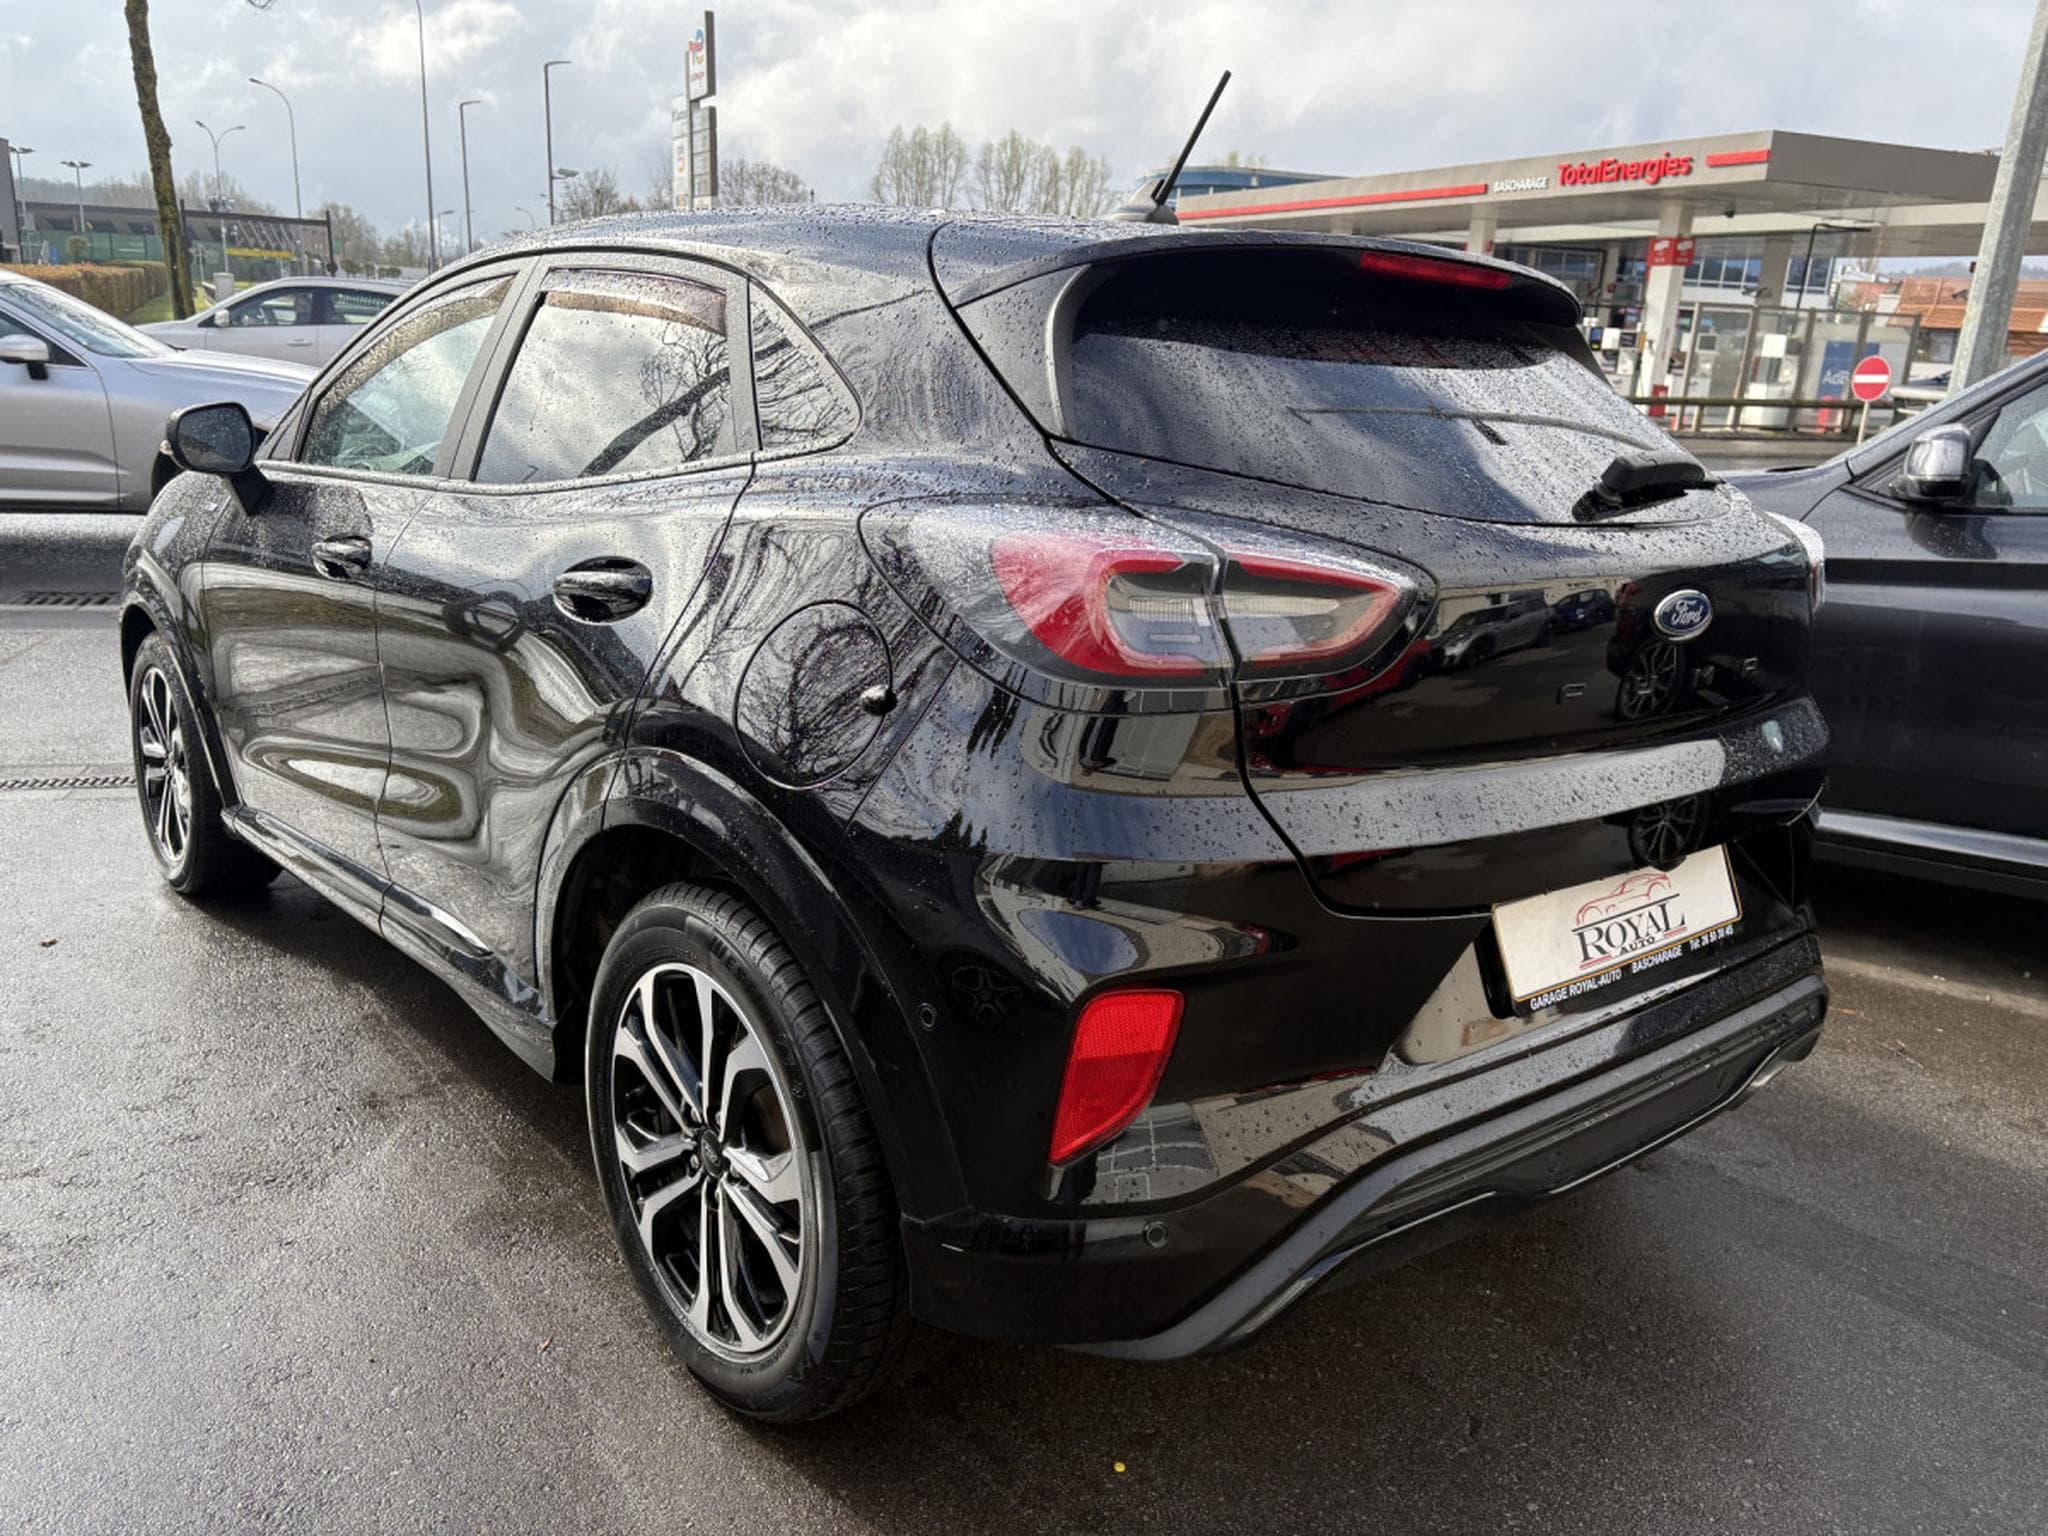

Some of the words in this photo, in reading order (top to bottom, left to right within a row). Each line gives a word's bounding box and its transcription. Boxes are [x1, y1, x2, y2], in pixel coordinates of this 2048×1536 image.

[1556, 151, 1692, 186] TotalEnergies
[1670, 599, 1702, 625] Ford
[1575, 901, 1686, 963] ROYAL
[1619, 937, 1656, 956] AUTO
[1530, 987, 1568, 1010] GARAGE
[1569, 969, 1622, 998] ROYAL-AUTO
[1632, 946, 1682, 974] BASCHARAGE
